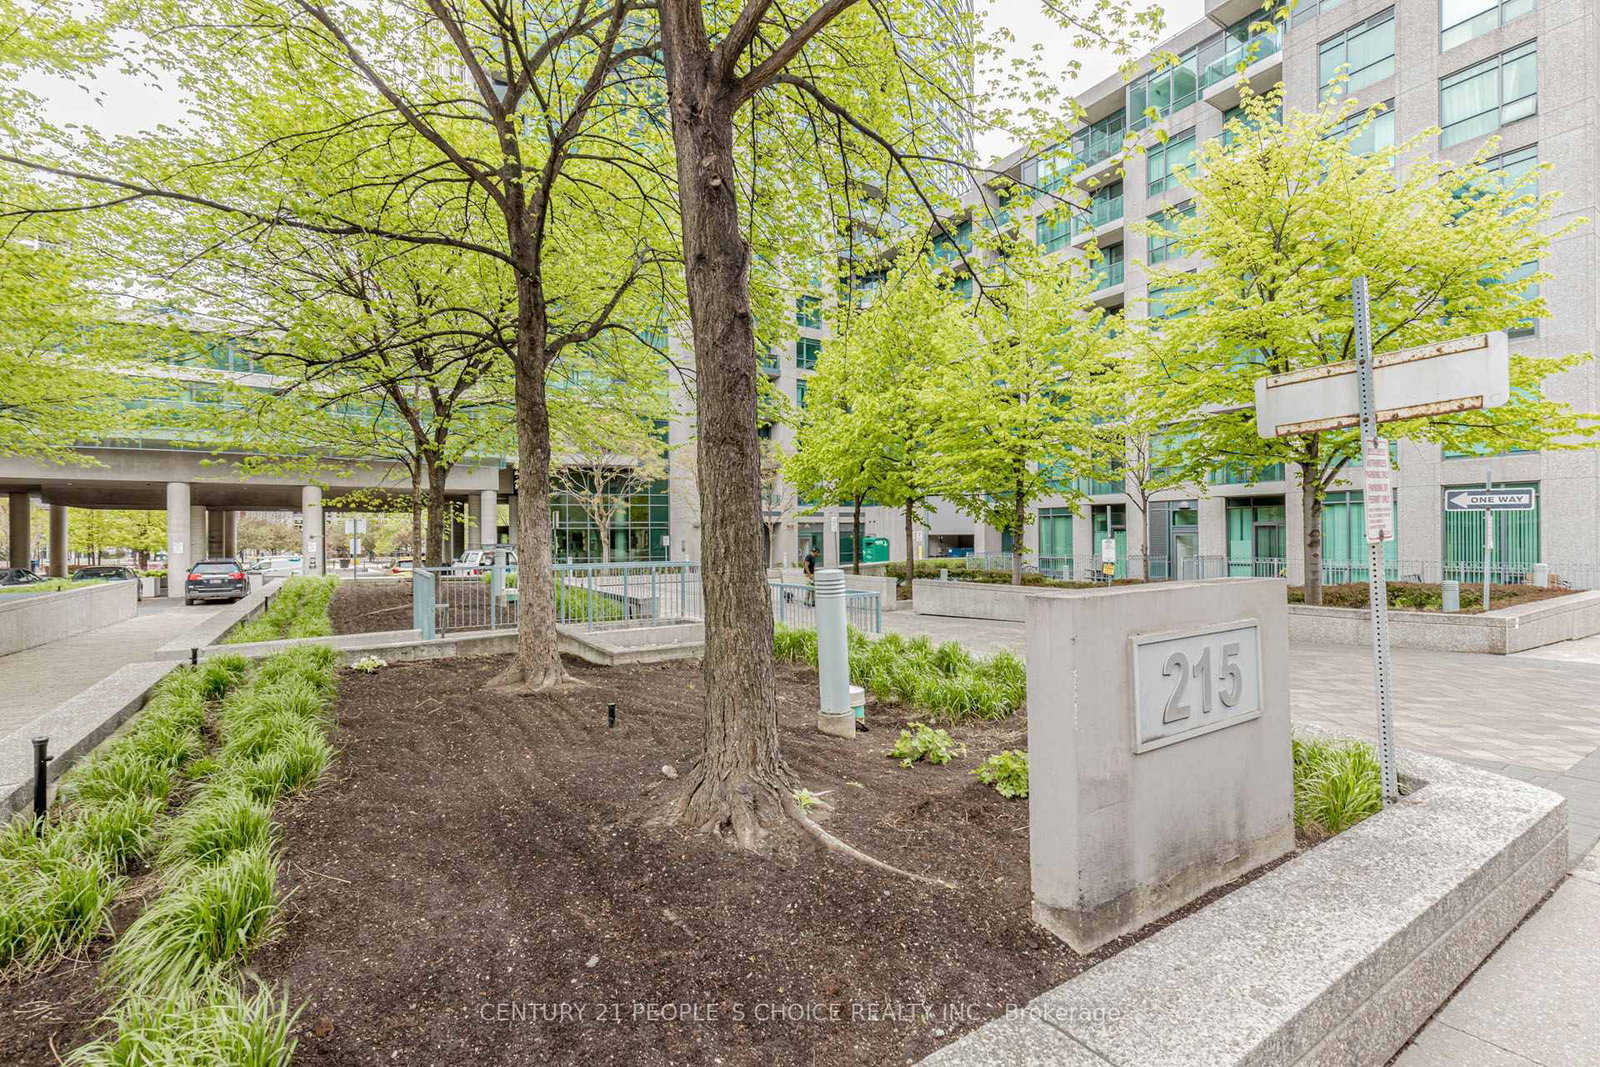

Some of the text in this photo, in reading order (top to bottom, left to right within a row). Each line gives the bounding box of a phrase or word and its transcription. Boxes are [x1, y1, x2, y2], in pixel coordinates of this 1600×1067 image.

[1470, 495, 1524, 504] ONE WAY
[1161, 642, 1242, 725] 215
